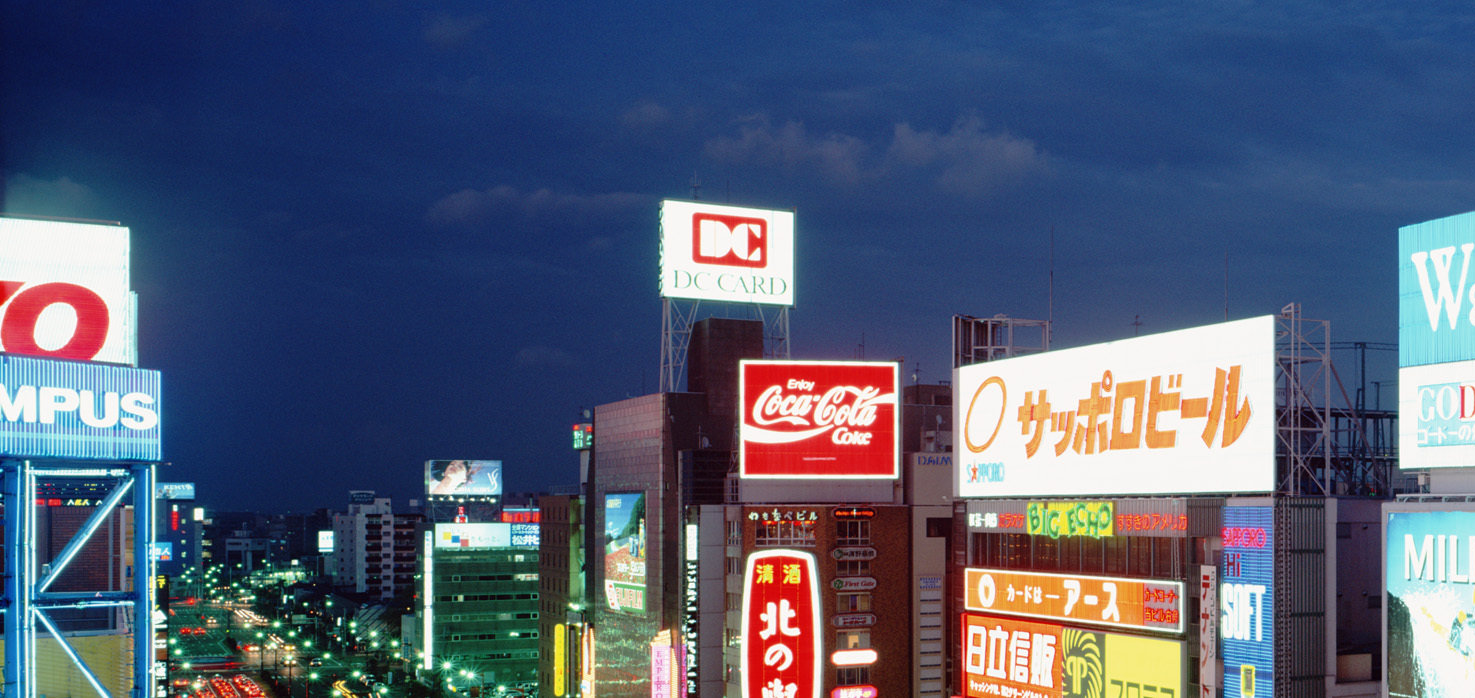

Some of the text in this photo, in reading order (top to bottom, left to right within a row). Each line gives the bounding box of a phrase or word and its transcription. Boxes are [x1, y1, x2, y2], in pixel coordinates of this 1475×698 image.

[700, 219, 761, 261] DC
[673, 270, 787, 296] DC CARD
[0, 280, 109, 360] O
[787, 379, 815, 391] Enjoy
[0, 384, 157, 430] MPUS
[752, 385, 880, 426] Coca-Cola
[1018, 365, 1252, 459] サッポロビール
[832, 427, 872, 445] Coke
[1028, 503, 1061, 539] BIG
[1066, 502, 1113, 539] ECHO
[1221, 527, 1267, 548] SAPPORO
[756, 564, 801, 584] 清酒
[1226, 553, 1241, 578] Hi
[1221, 583, 1266, 642] SOFT
[965, 624, 1058, 688] 日立信販
